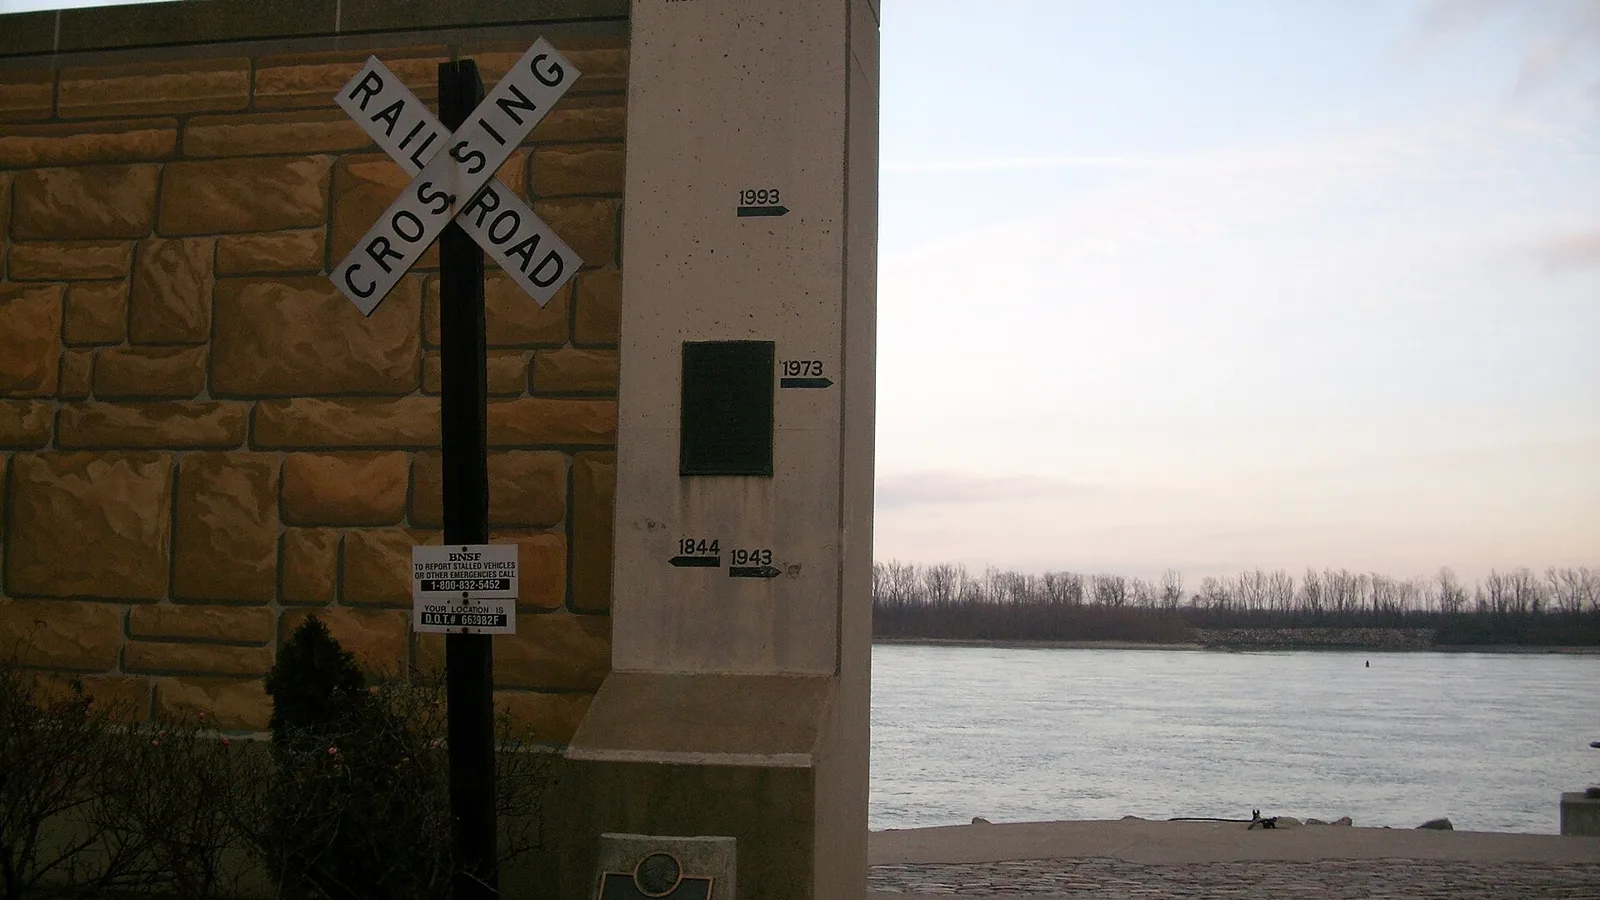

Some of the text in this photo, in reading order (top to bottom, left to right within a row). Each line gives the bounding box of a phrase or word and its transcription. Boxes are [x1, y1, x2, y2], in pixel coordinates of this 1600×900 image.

[349, 70, 438, 169] RAIL
[740, 189, 780, 205] 1993
[464, 186, 564, 288] ROAD
[782, 360, 823, 376] 1973
[679, 538, 720, 555] 1844
[449, 553, 481, 561] BNSF
[731, 549, 772, 565] 1943
[415, 563, 423, 571] TO
[425, 563, 451, 571] REPORT
[453, 562, 482, 570] STALLED
[426, 571, 448, 579] OTHER
[450, 571, 497, 579] EMERGENCIES
[499, 570, 515, 578] CALL
[431, 580, 500, 590] 1-800-832-5452
[424, 605, 504, 614] YOUR LOCATION IS
